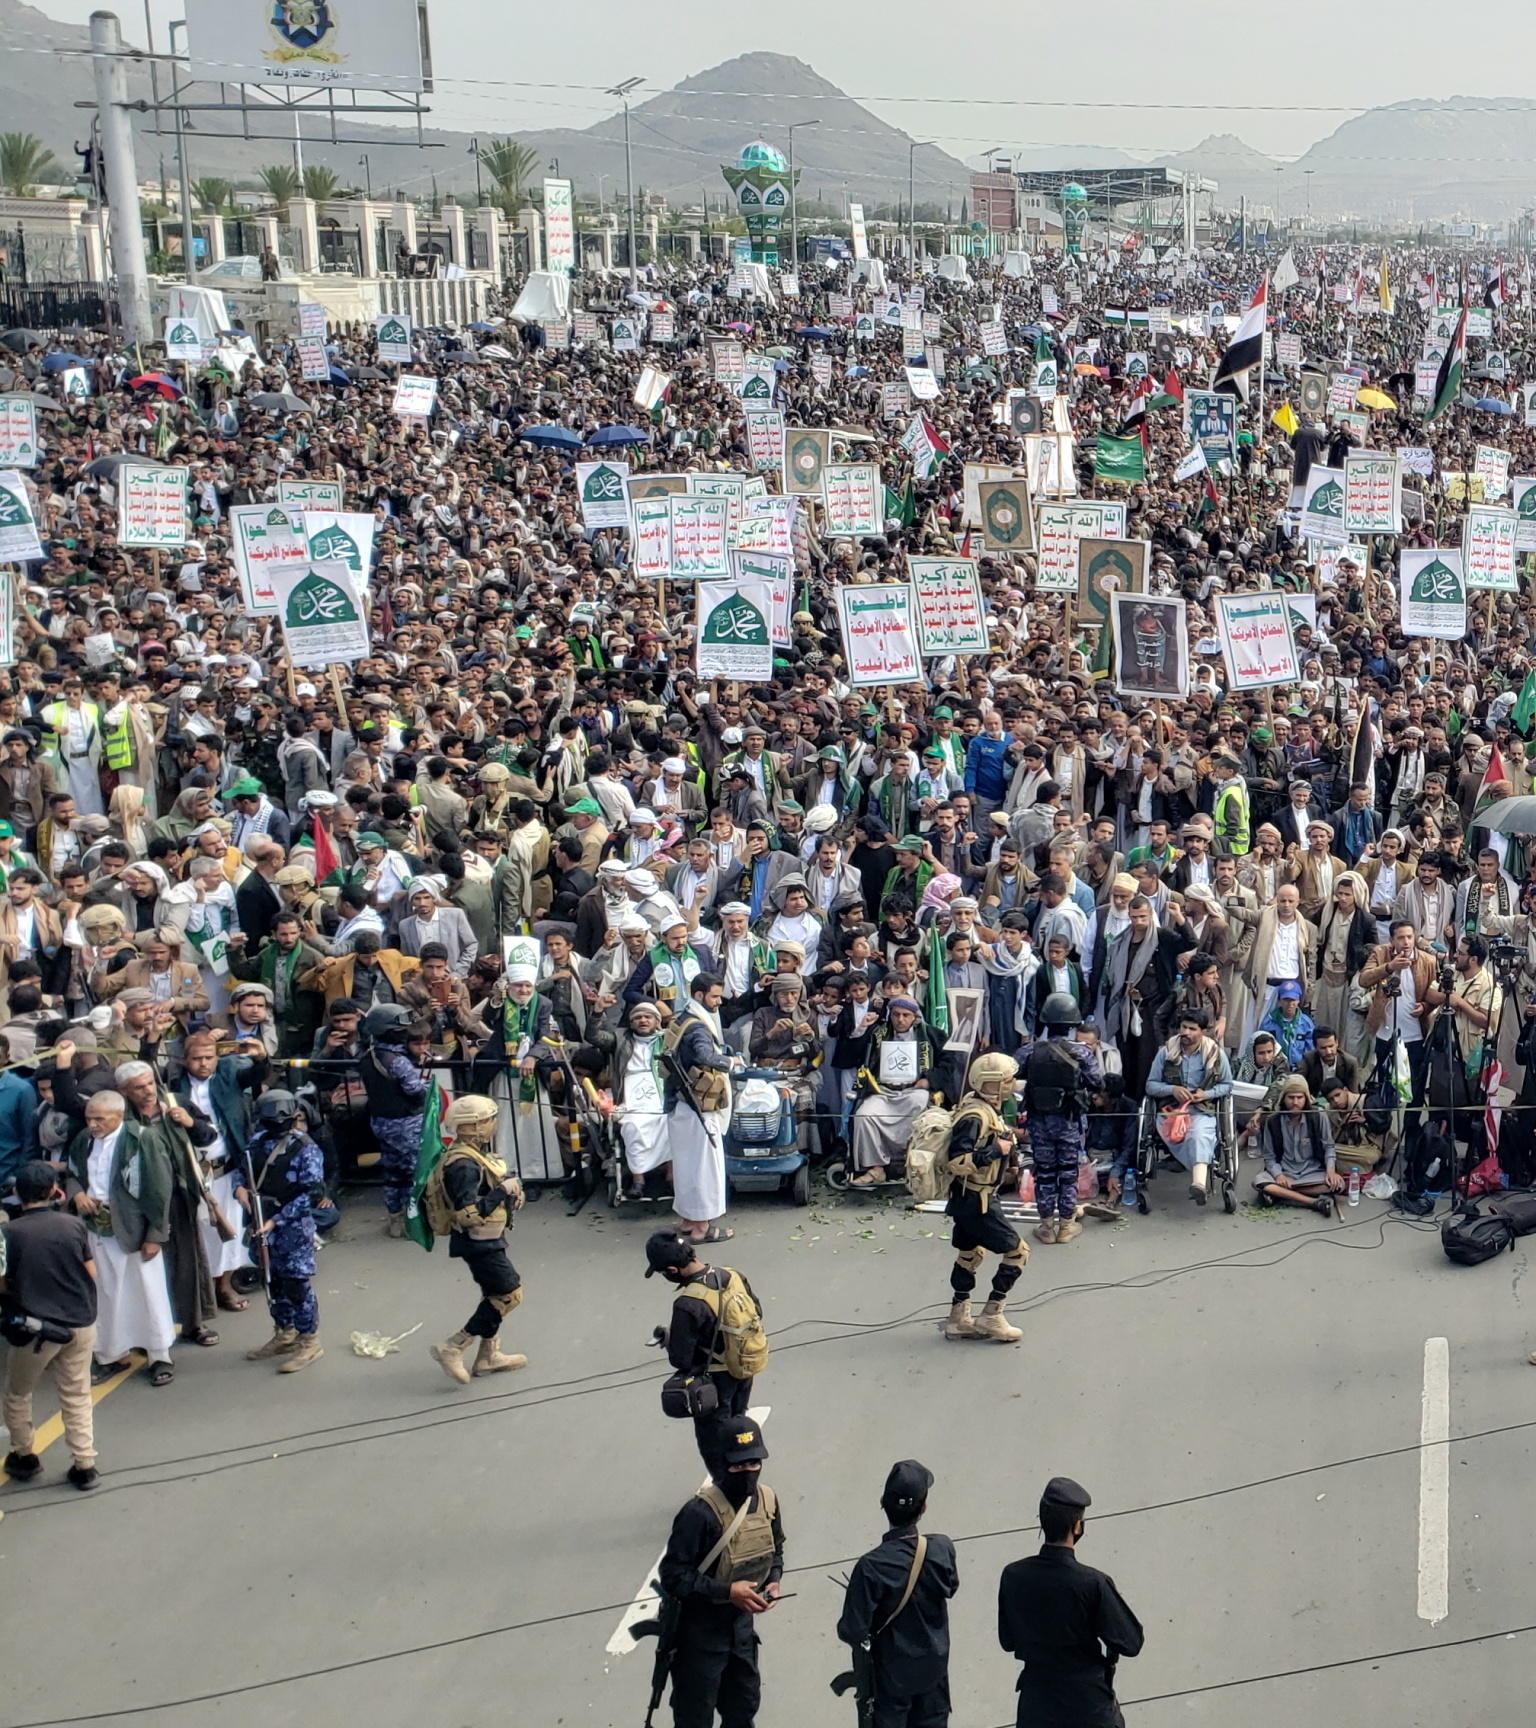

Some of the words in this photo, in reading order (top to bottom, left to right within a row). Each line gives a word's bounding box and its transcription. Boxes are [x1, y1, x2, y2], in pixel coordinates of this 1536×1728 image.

[951, 566, 972, 579] الله
[950, 587, 974, 596] الموت
[1420, 570, 1456, 599] محمد
[847, 593, 907, 615] قاطعوا
[952, 599, 976, 612] الموت
[1225, 601, 1281, 621] قاطعوا
[715, 604, 762, 639] محمد
[882, 617, 907, 633] البضائع
[924, 618, 944, 628] اليهود
[946, 617, 957, 628] على
[960, 615, 978, 625] اللعنة
[956, 629, 981, 644] النصر
[1259, 623, 1285, 638] البضائع
[878, 639, 883, 650] و
[925, 631, 954, 647] للإسلام
[1257, 645, 1261, 655] و
